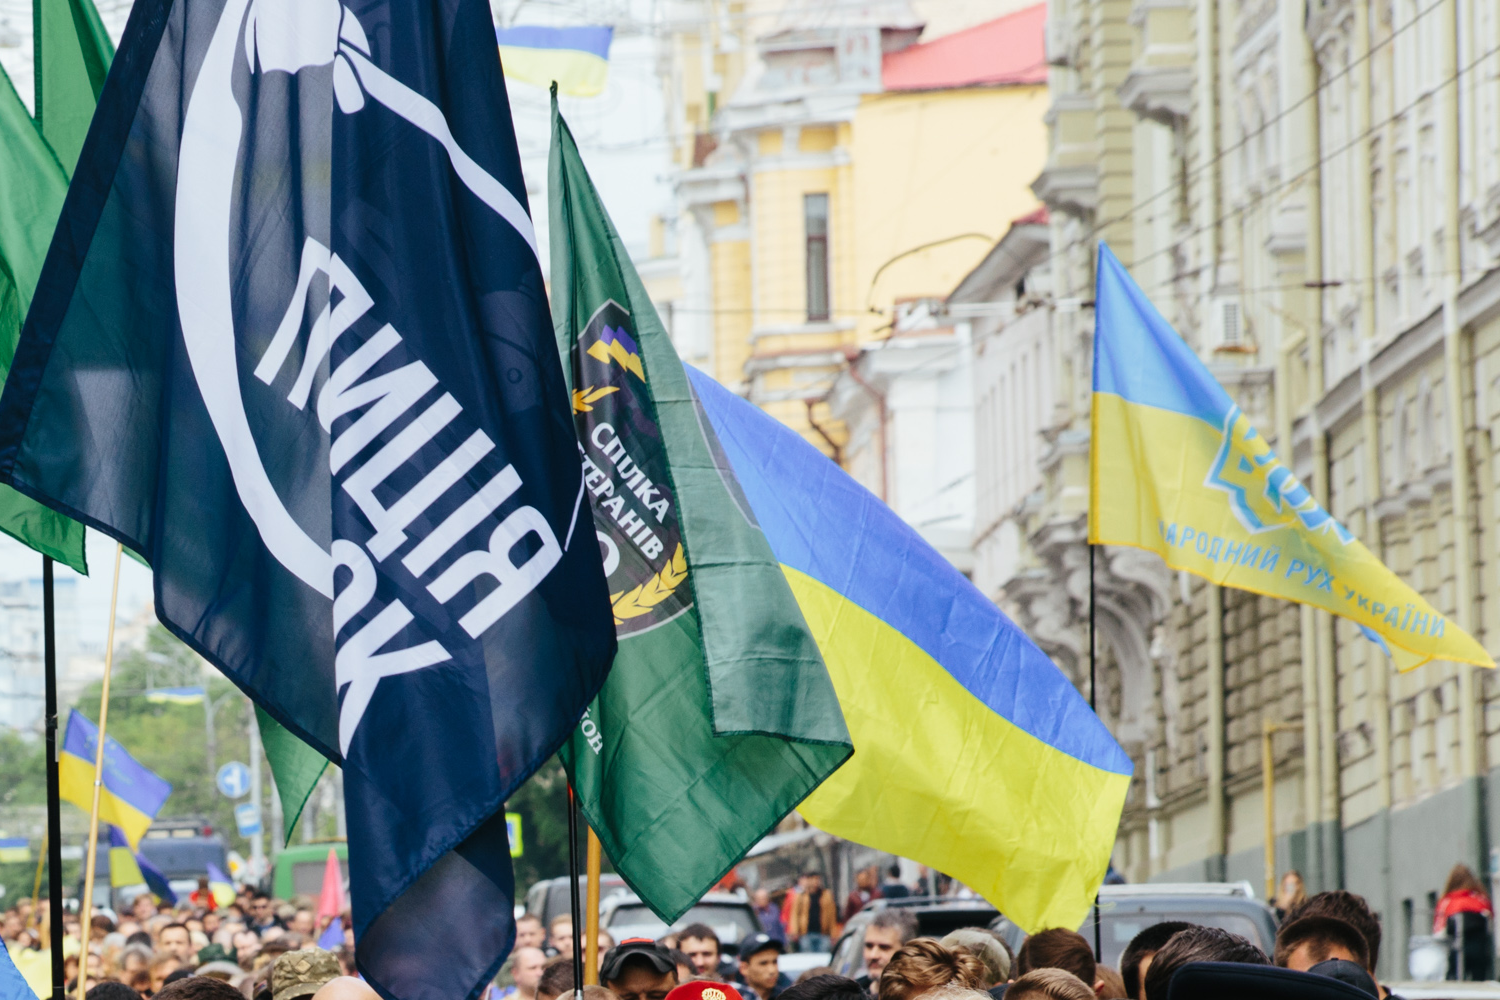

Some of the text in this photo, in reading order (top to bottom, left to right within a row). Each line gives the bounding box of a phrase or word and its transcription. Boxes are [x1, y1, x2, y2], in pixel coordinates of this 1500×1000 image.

[591, 422, 670, 524] СПІЛКА
[1284, 557, 1336, 593] РУХ
[1341, 584, 1447, 639] УКРАЇНИ
